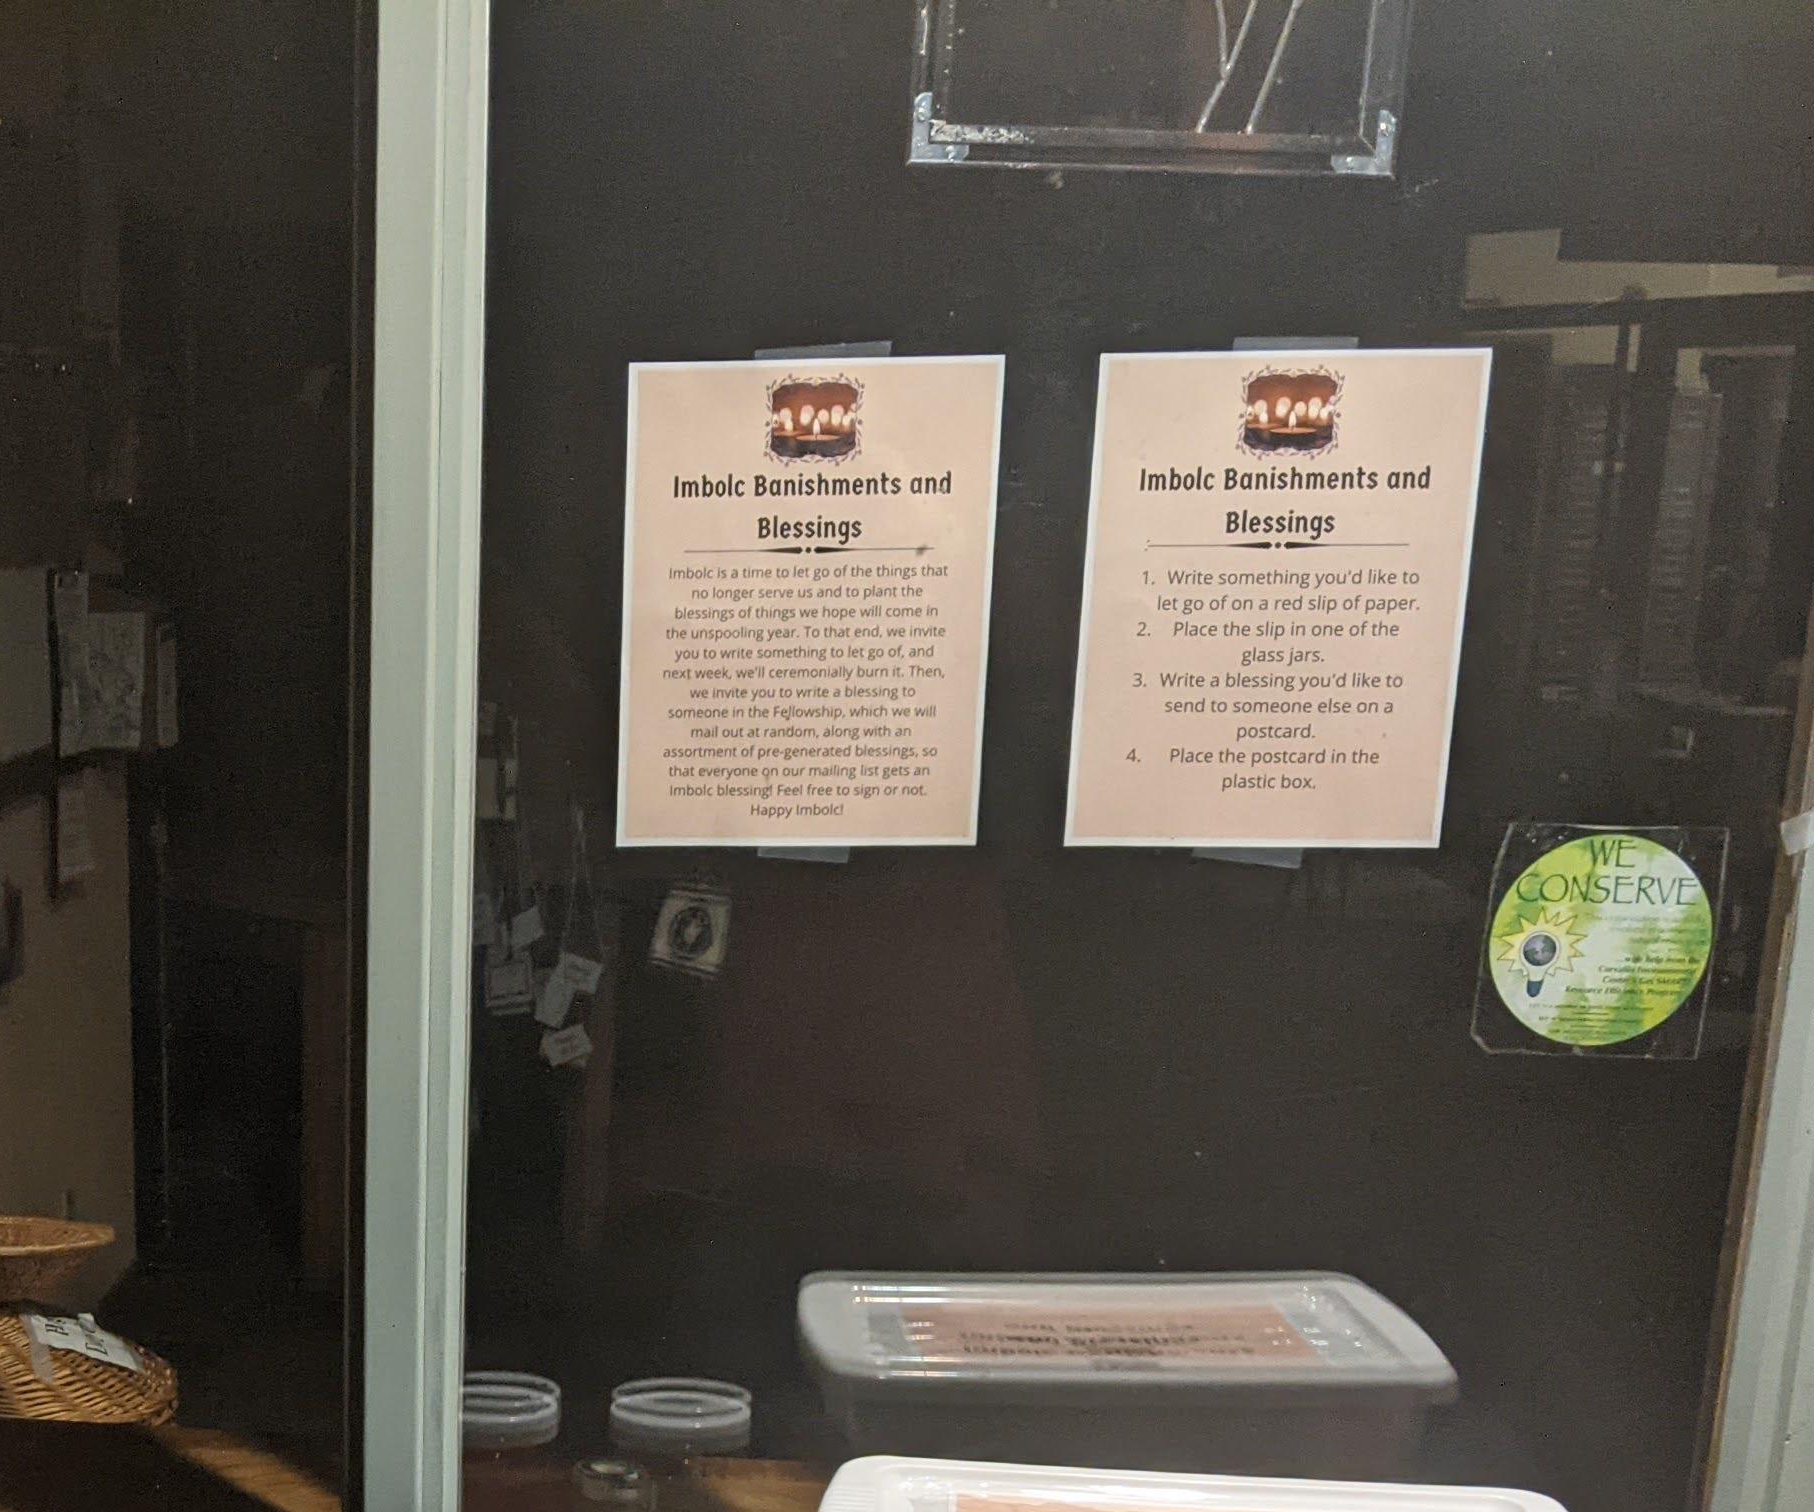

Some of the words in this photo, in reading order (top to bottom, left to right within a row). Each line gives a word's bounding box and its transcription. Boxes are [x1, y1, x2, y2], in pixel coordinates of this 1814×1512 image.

[673, 473, 746, 499] Imbolc
[753, 471, 902, 498] Banishments
[910, 470, 953, 495] and
[1139, 466, 1216, 492] Imbolc
[1223, 465, 1379, 492] Banishments
[1386, 464, 1432, 490] and
[757, 514, 862, 546] Blessings
[1225, 509, 1336, 540] Blessings
[668, 565, 714, 580] Imbolc
[716, 566, 728, 580] is
[730, 568, 740, 580] a
[742, 567, 774, 580] time
[776, 566, 790, 580] to
[792, 564, 810, 579] let
[812, 567, 832, 582] go
[832, 563, 848, 579] of
[850, 564, 874, 579] the
[876, 564, 918, 581] things
[920, 563, 948, 577] that
[1142, 569, 1155, 586] 1.
[1166, 569, 1214, 586] Write
[1216, 568, 1311, 590] something
[1312, 568, 1363, 590] you'd
[1366, 568, 1398, 586] like
[1401, 570, 1420, 585] to
[690, 588, 709, 601] no
[711, 586, 755, 604] longer
[757, 587, 795, 599] serve
[796, 587, 814, 599] us
[815, 584, 843, 599] and
[844, 586, 860, 599] to
[861, 584, 898, 602] plant
[900, 583, 924, 598] the
[674, 606, 736, 623] blessings
[736, 605, 754, 620] of
[754, 605, 796, 624] things
[798, 607, 820, 619] we
[820, 604, 858, 622] hope
[858, 604, 882, 619] will
[884, 606, 924, 619] come
[926, 604, 938, 617] in
[1157, 595, 1180, 612] let
[1181, 598, 1206, 617] go
[1208, 593, 1230, 612] of
[1231, 597, 1255, 611] on
[1258, 598, 1270, 611] a
[1274, 593, 1304, 611] red
[1307, 593, 1339, 615] slip
[1342, 593, 1363, 611] of
[1364, 597, 1421, 615] paper.
[665, 626, 688, 641] the
[689, 625, 765, 644] unspooling
[765, 628, 800, 643] year.
[802, 624, 821, 639] To
[822, 624, 851, 639] that
[852, 623, 883, 639] end,
[885, 626, 907, 639] we
[908, 625, 946, 639] invite
[1136, 620, 1152, 637] 2.
[1173, 619, 1219, 637] Place
[1222, 620, 1252, 637] the
[1255, 620, 1286, 641] slip
[1290, 620, 1307, 637] in
[1311, 624, 1345, 637] one
[1348, 619, 1370, 637] of
[1371, 619, 1400, 637] the
[1240, 645, 1285, 667] glass
[1285, 646, 1325, 667] jars.
[1132, 672, 1148, 688] 3.
[1159, 672, 1206, 689] Write
[1209, 675, 1221, 689] a
[1225, 671, 1297, 693] blessing
[1297, 672, 1348, 693] you'd
[1351, 672, 1382, 689] like
[1385, 674, 1404, 689] to
[1164, 697, 1207, 713] send
[1210, 699, 1229, 714] to
[1232, 700, 1314, 715] someone
[1317, 697, 1353, 715] else
[1356, 701, 1380, 714] on
[1383, 701, 1395, 715] a
[1235, 722, 1316, 742] postcard.
[1125, 748, 1141, 764] 4.
[1169, 747, 1214, 765] Place
[1217, 747, 1247, 765] the
[1250, 748, 1327, 769] postcard
[1330, 748, 1347, 765] in
[1351, 748, 1380, 765] the
[1221, 772, 1277, 793] plastic
[1280, 773, 1316, 790] box.
[749, 803, 794, 820] Happy
[795, 803, 844, 817] Imbolc!
[1590, 839, 1636, 868] WE
[1516, 874, 1698, 906] CONSERVE
